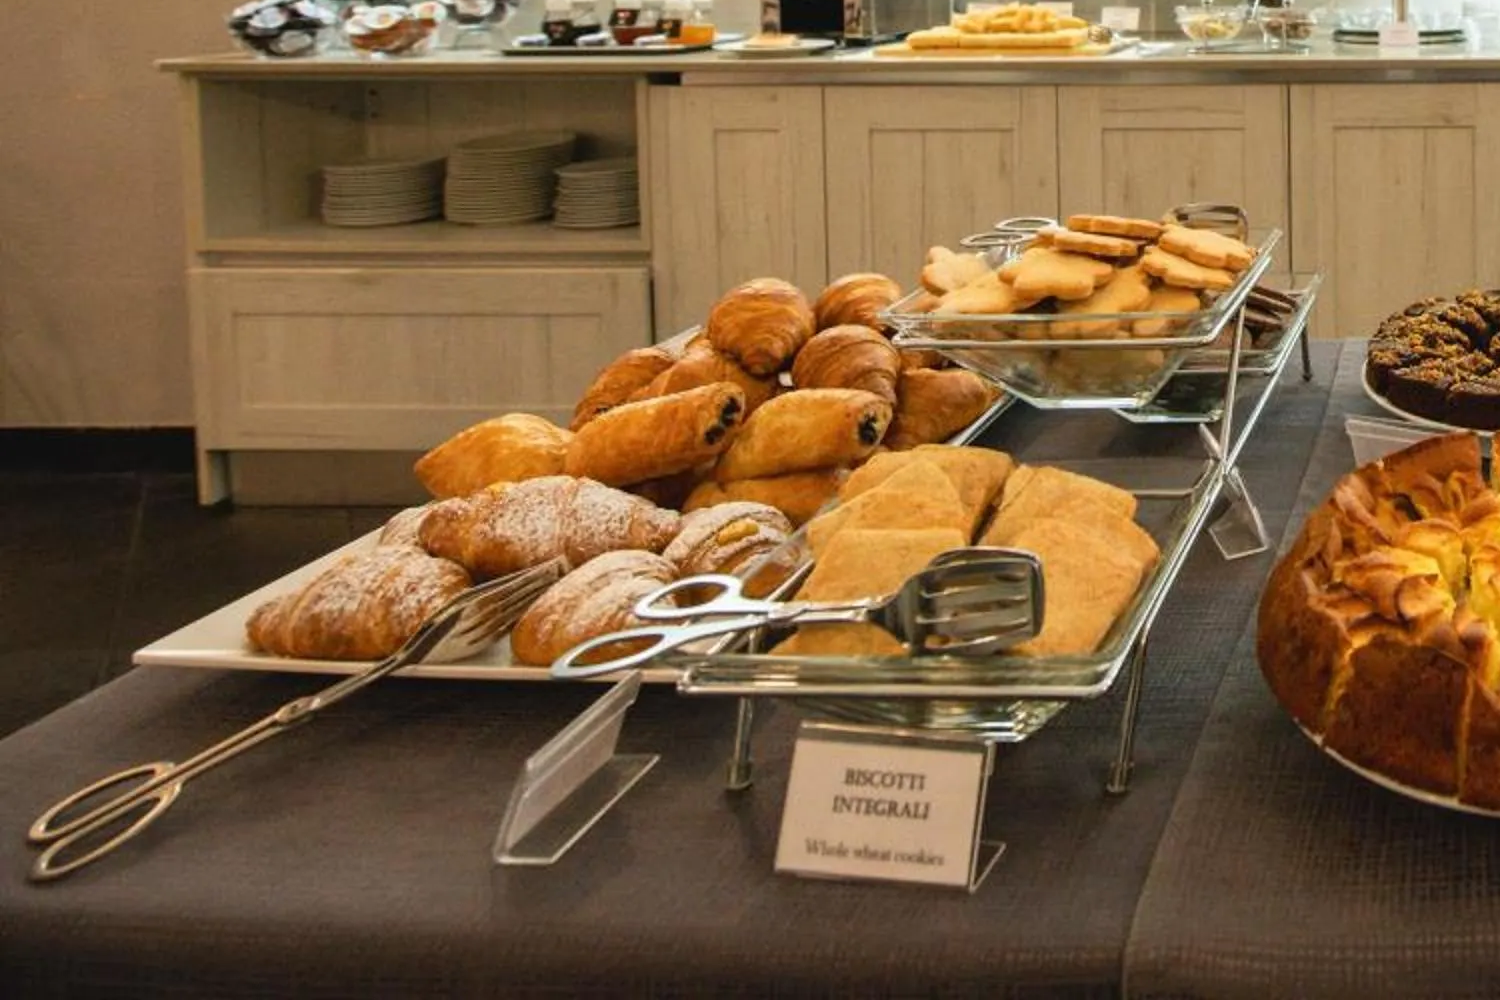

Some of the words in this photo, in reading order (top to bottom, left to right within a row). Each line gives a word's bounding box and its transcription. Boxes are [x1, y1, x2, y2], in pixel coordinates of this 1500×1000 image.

[844, 767, 927, 791] BISCOTTI
[832, 796, 930, 820] INTEGRALI
[805, 837, 849, 858] Whole
[853, 844, 890, 861] wheat
[893, 848, 946, 866] cookies
